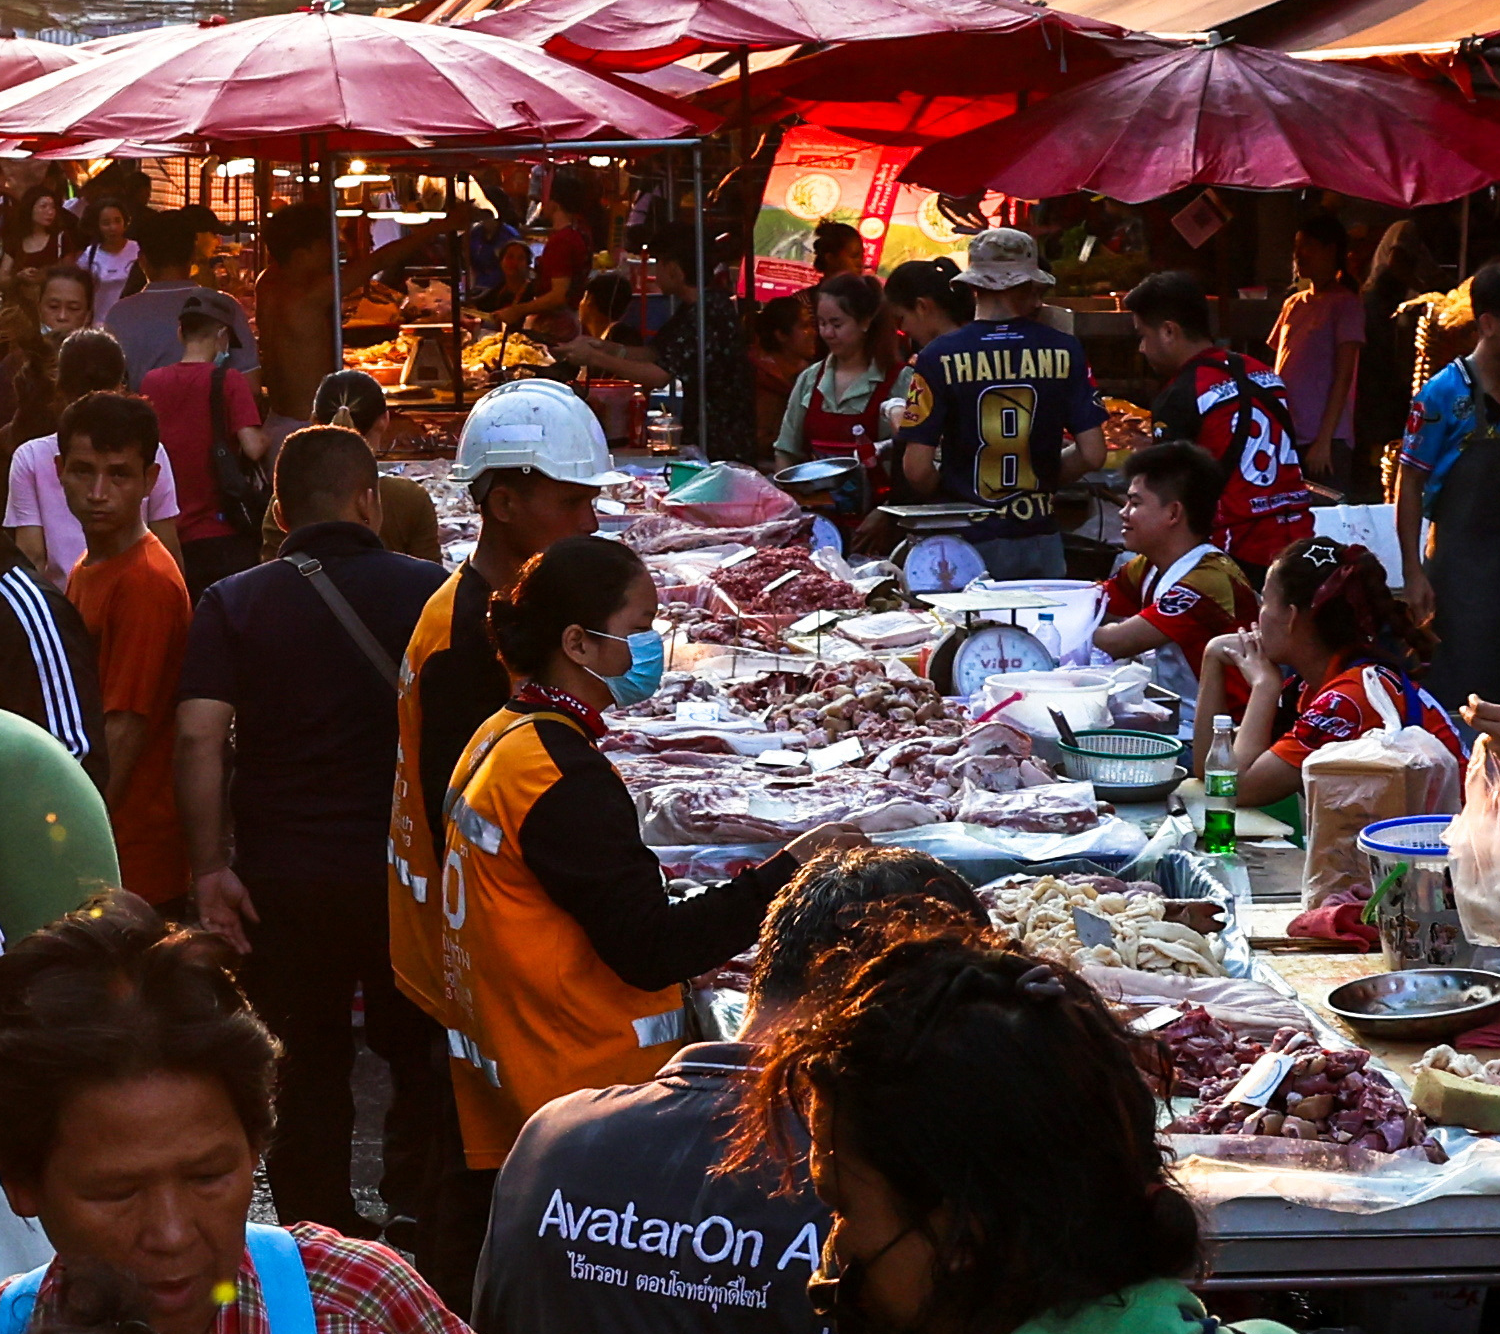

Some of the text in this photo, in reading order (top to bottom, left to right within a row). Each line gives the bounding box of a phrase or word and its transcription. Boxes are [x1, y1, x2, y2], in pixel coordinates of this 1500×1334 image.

[940, 349, 1071, 385] THAILAND
[973, 384, 1039, 503] 8
[539, 1188, 764, 1268] AvatarOn
[568, 1250, 627, 1289] ไร้กรอบ
